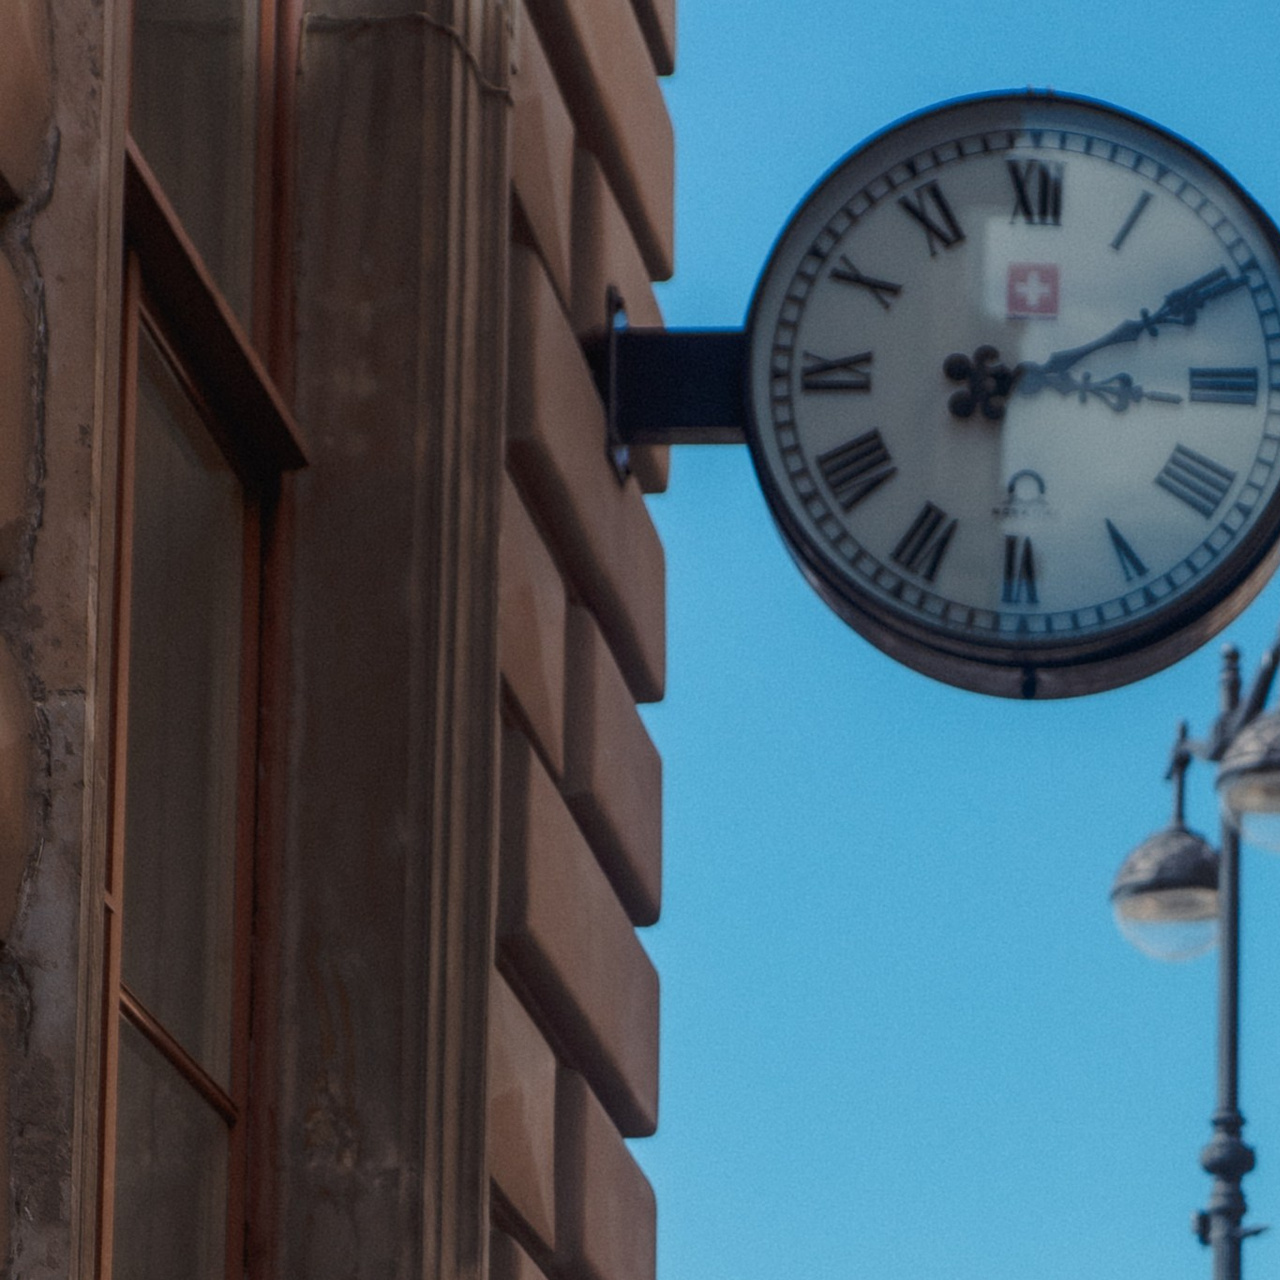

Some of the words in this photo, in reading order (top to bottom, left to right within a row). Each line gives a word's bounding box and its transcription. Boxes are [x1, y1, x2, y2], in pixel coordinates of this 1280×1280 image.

[899, 178, 966, 256] XI
[1006, 159, 1063, 226] XII
[1110, 190, 1153, 250] I
[831, 257, 902, 310] X
[802, 350, 873, 393] IX
[1188, 367, 1259, 405] III
[817, 428, 898, 511] VIII
[1155, 443, 1238, 520] IIII
[890, 500, 959, 584] VII
[1002, 533, 1038, 604] VI
[1105, 517, 1149, 582] V
